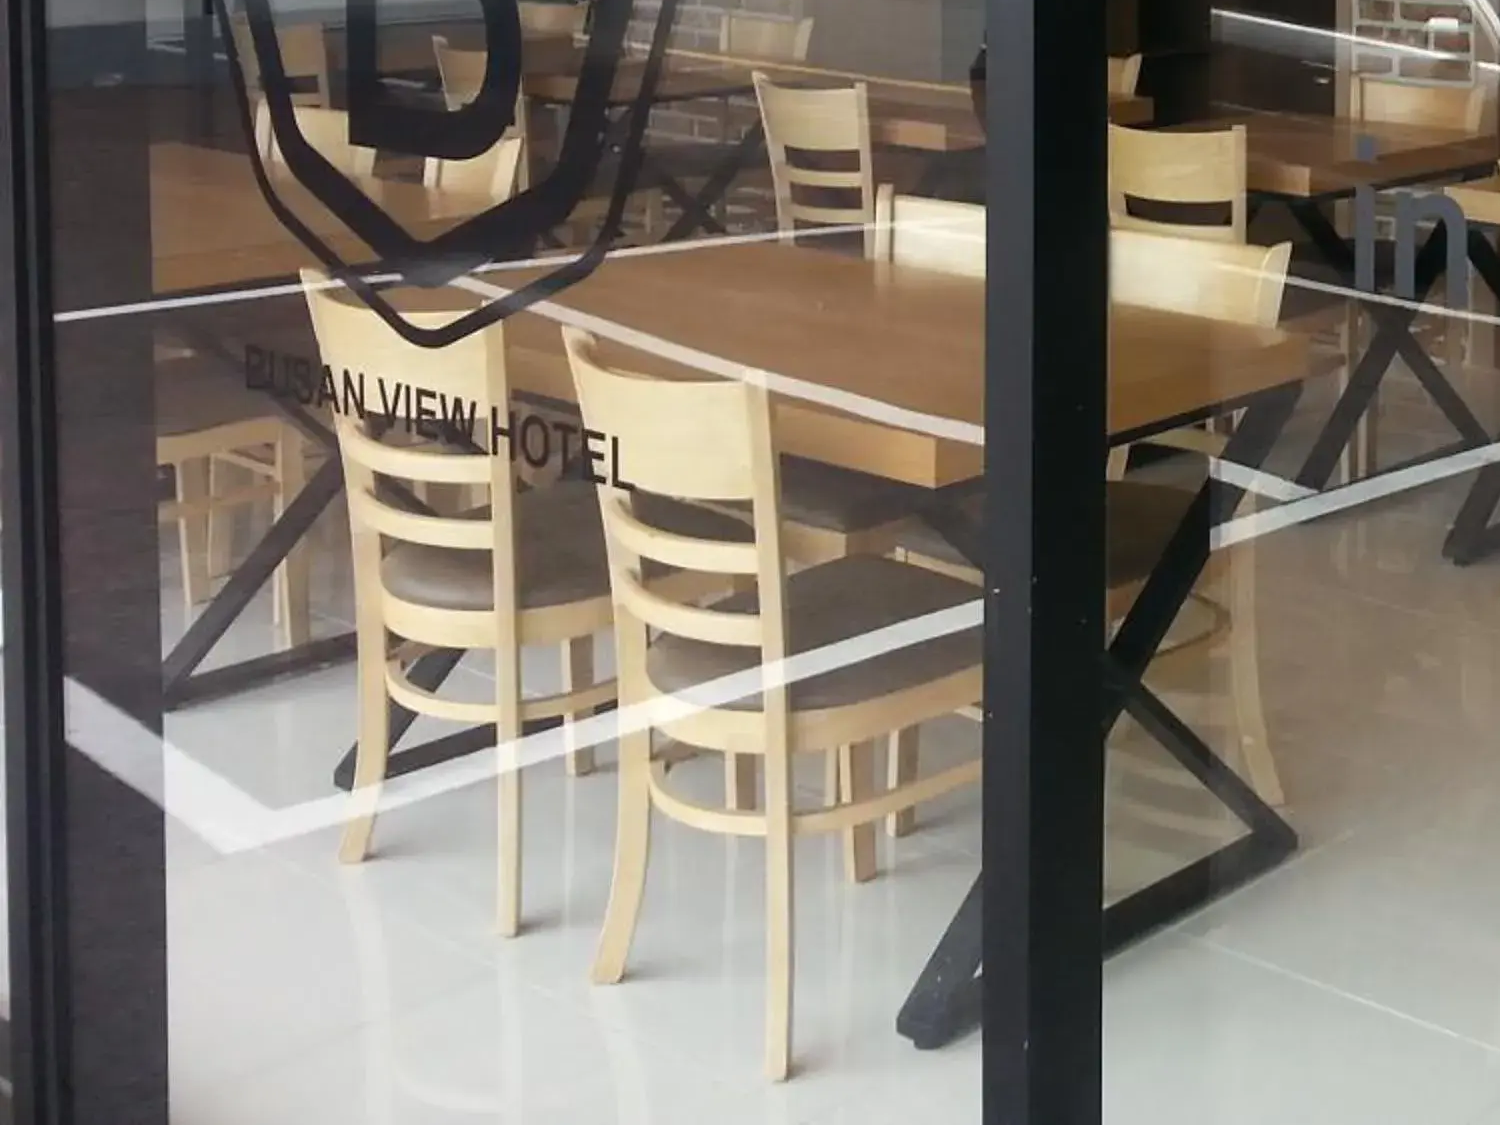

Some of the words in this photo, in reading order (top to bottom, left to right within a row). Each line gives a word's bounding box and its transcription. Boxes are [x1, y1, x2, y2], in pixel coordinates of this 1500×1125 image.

[1354, 134, 1468, 297] in
[245, 344, 366, 419] BUSAN
[378, 377, 478, 445] VIEW
[492, 406, 636, 492] HOTEL
